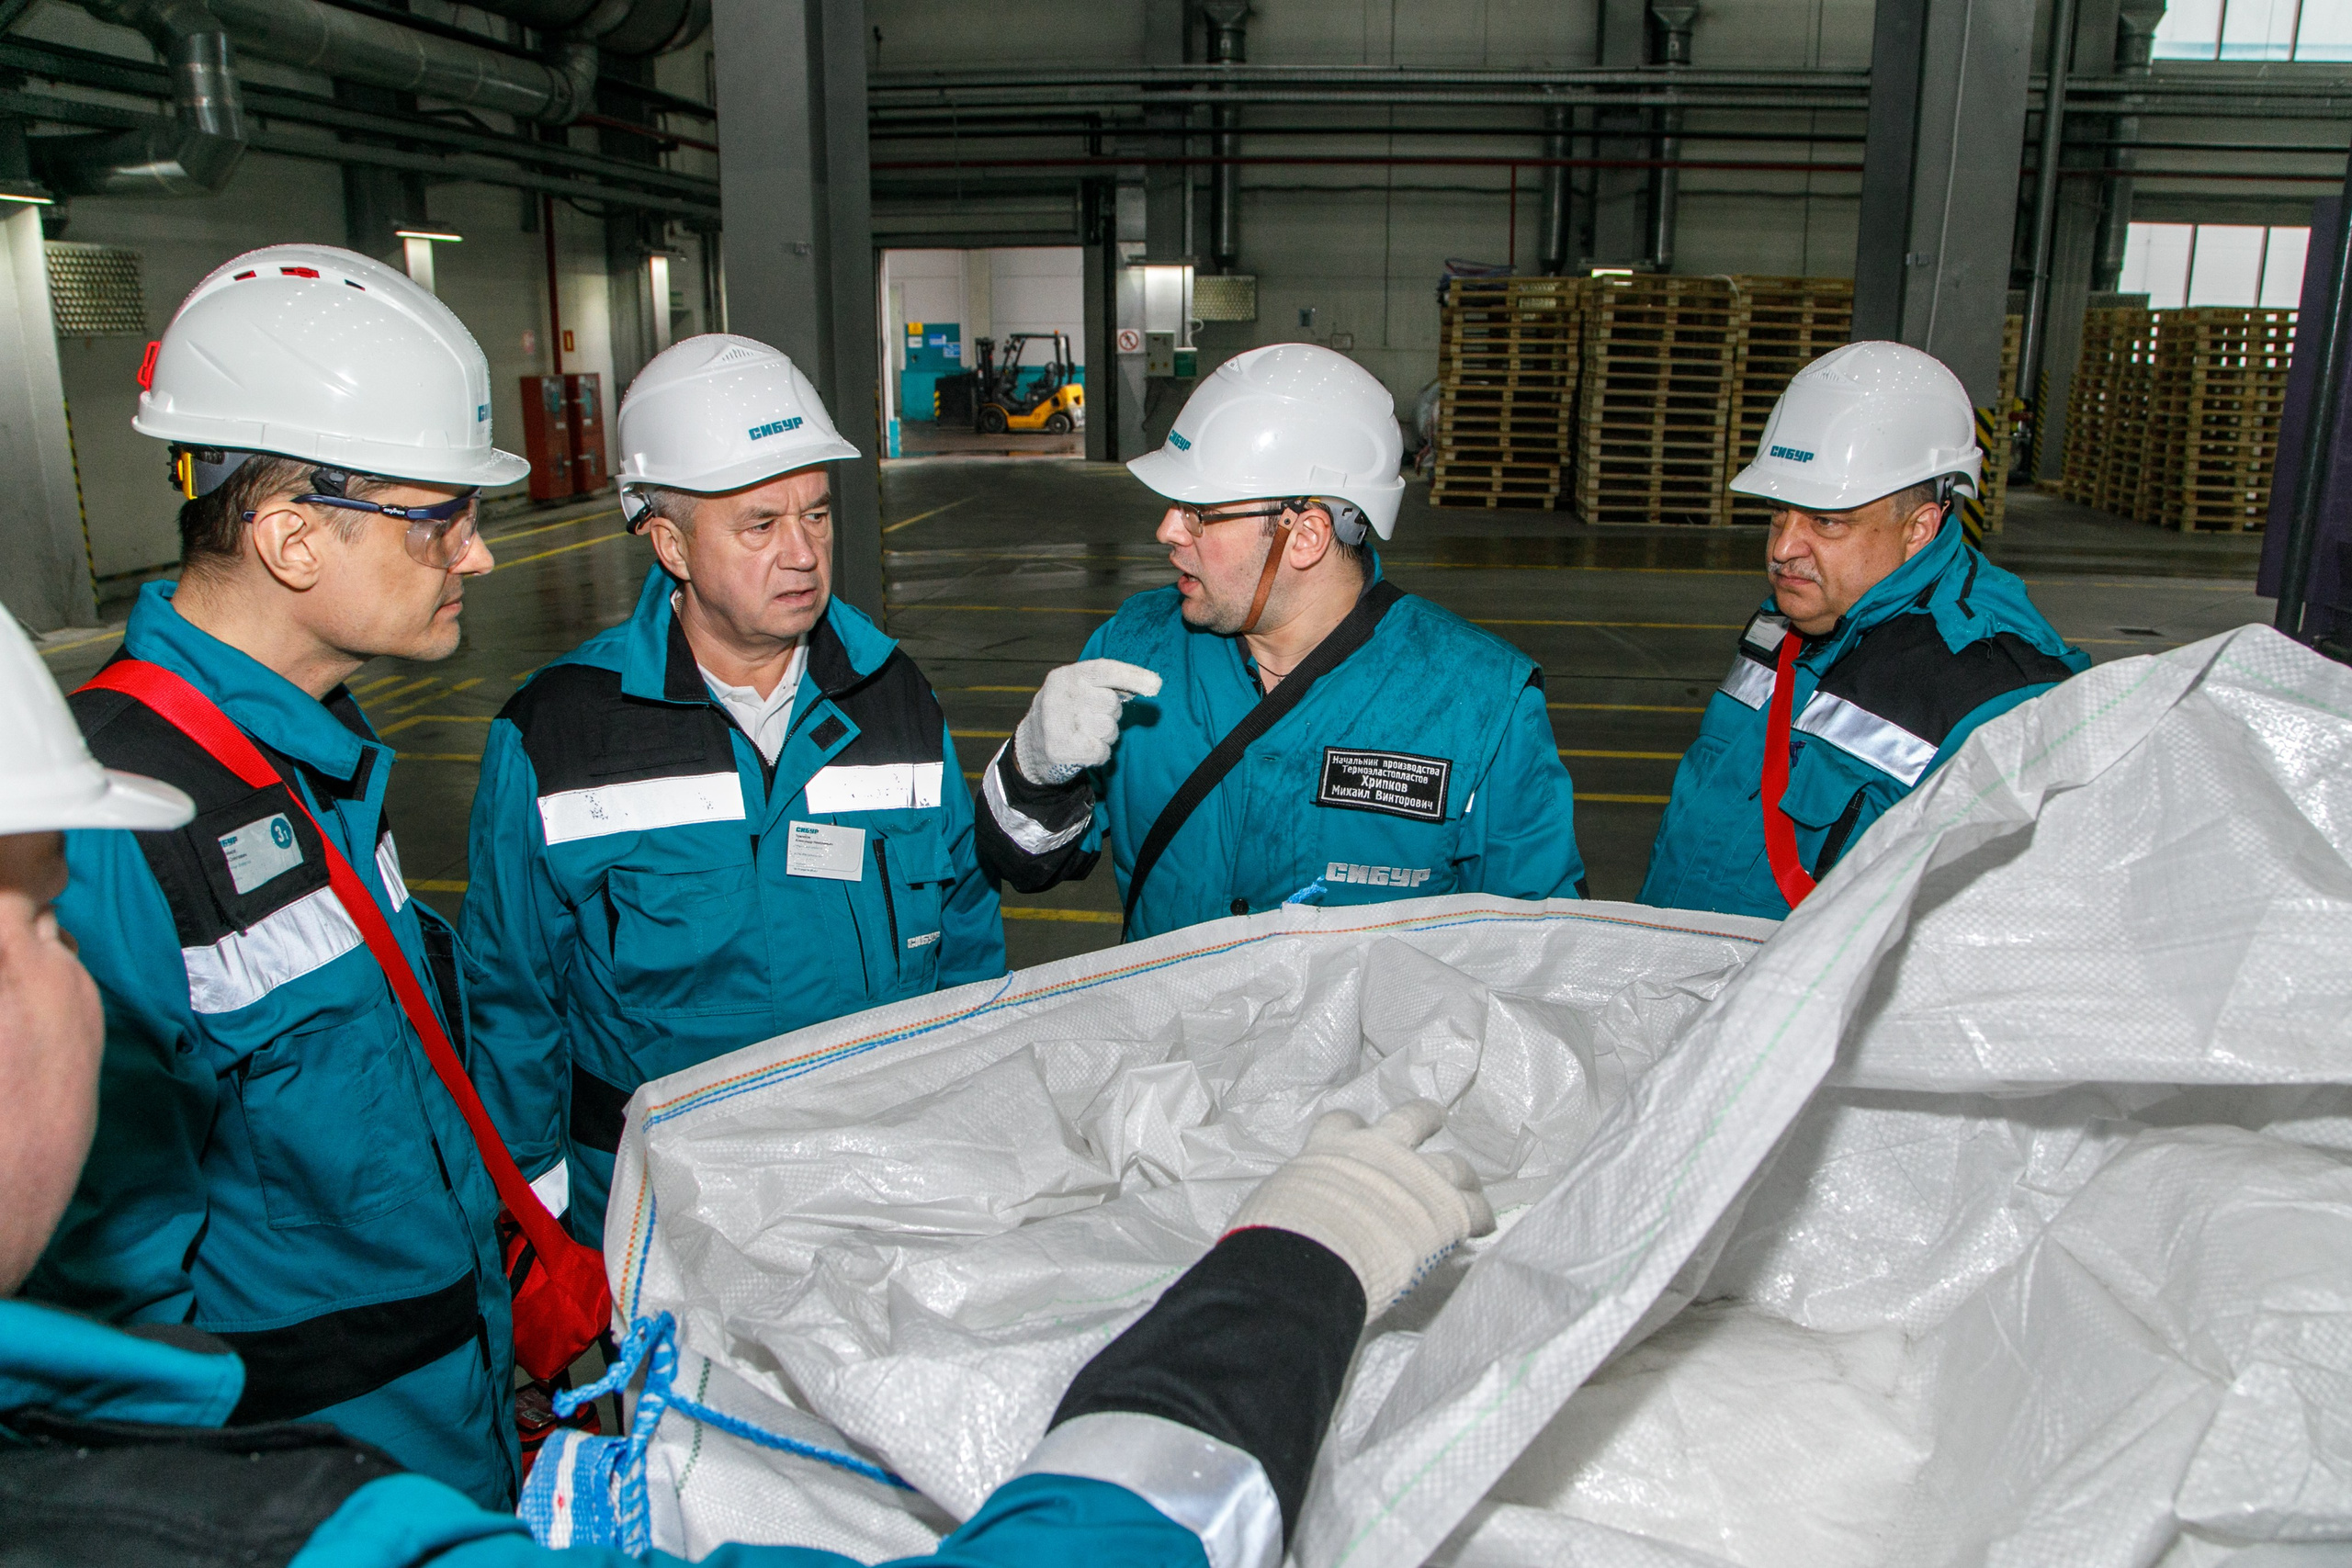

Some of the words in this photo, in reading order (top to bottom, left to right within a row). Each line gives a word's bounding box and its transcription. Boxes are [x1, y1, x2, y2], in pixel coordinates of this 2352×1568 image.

[748, 416, 804, 441] СИБУР
[1770, 445, 1815, 463] СИБУР
[1331, 755, 1379, 766] Начальник
[1383, 760, 1441, 776] производства
[1342, 764, 1429, 784] Термоэластопластов
[1361, 774, 1408, 793] Хрипков
[1331, 784, 1371, 799] Михаил
[1374, 790, 1433, 810] Викторович
[795, 826, 820, 835] СИБУР
[1325, 862, 1431, 887] СИБУР
